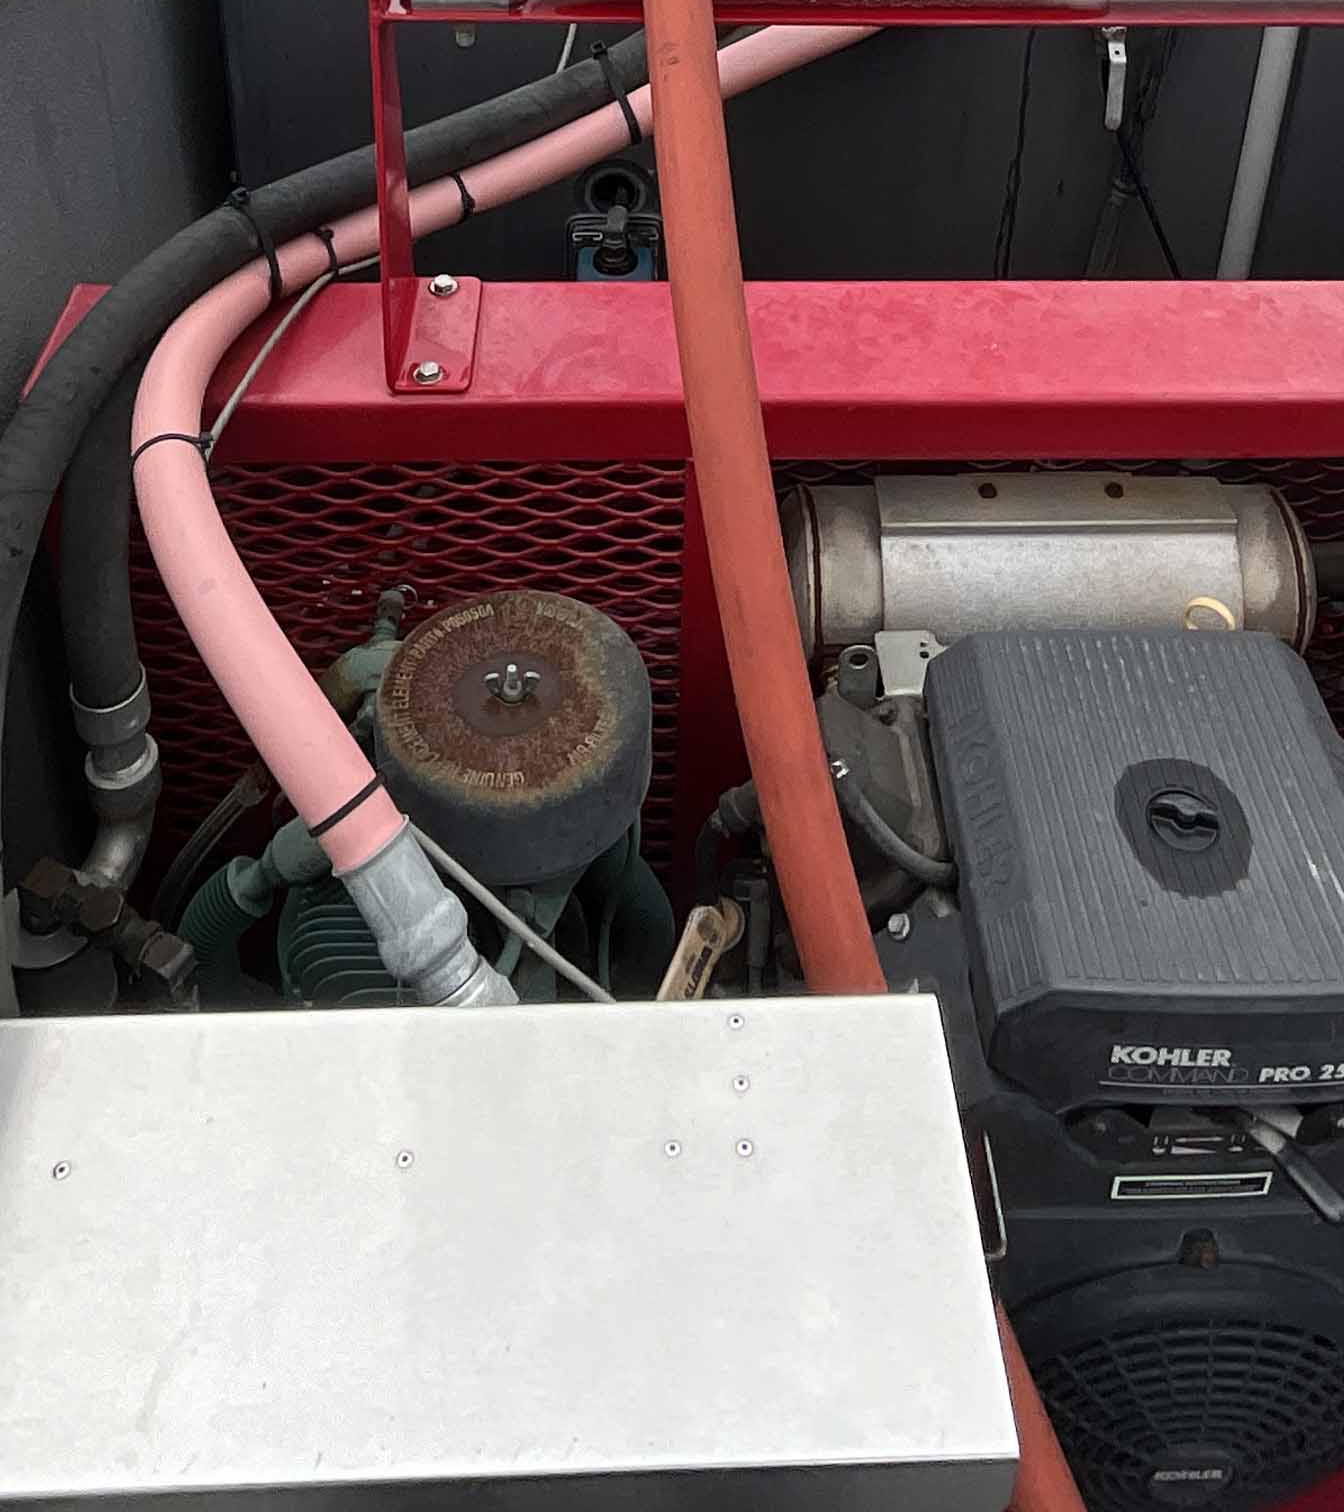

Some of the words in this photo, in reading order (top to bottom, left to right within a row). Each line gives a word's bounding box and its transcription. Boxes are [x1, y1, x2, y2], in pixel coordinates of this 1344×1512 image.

[1111, 1044, 1232, 1066] KOHLER
[1108, 1065, 1249, 1083] COMMAND
[1258, 1066, 1311, 1083] PRO
